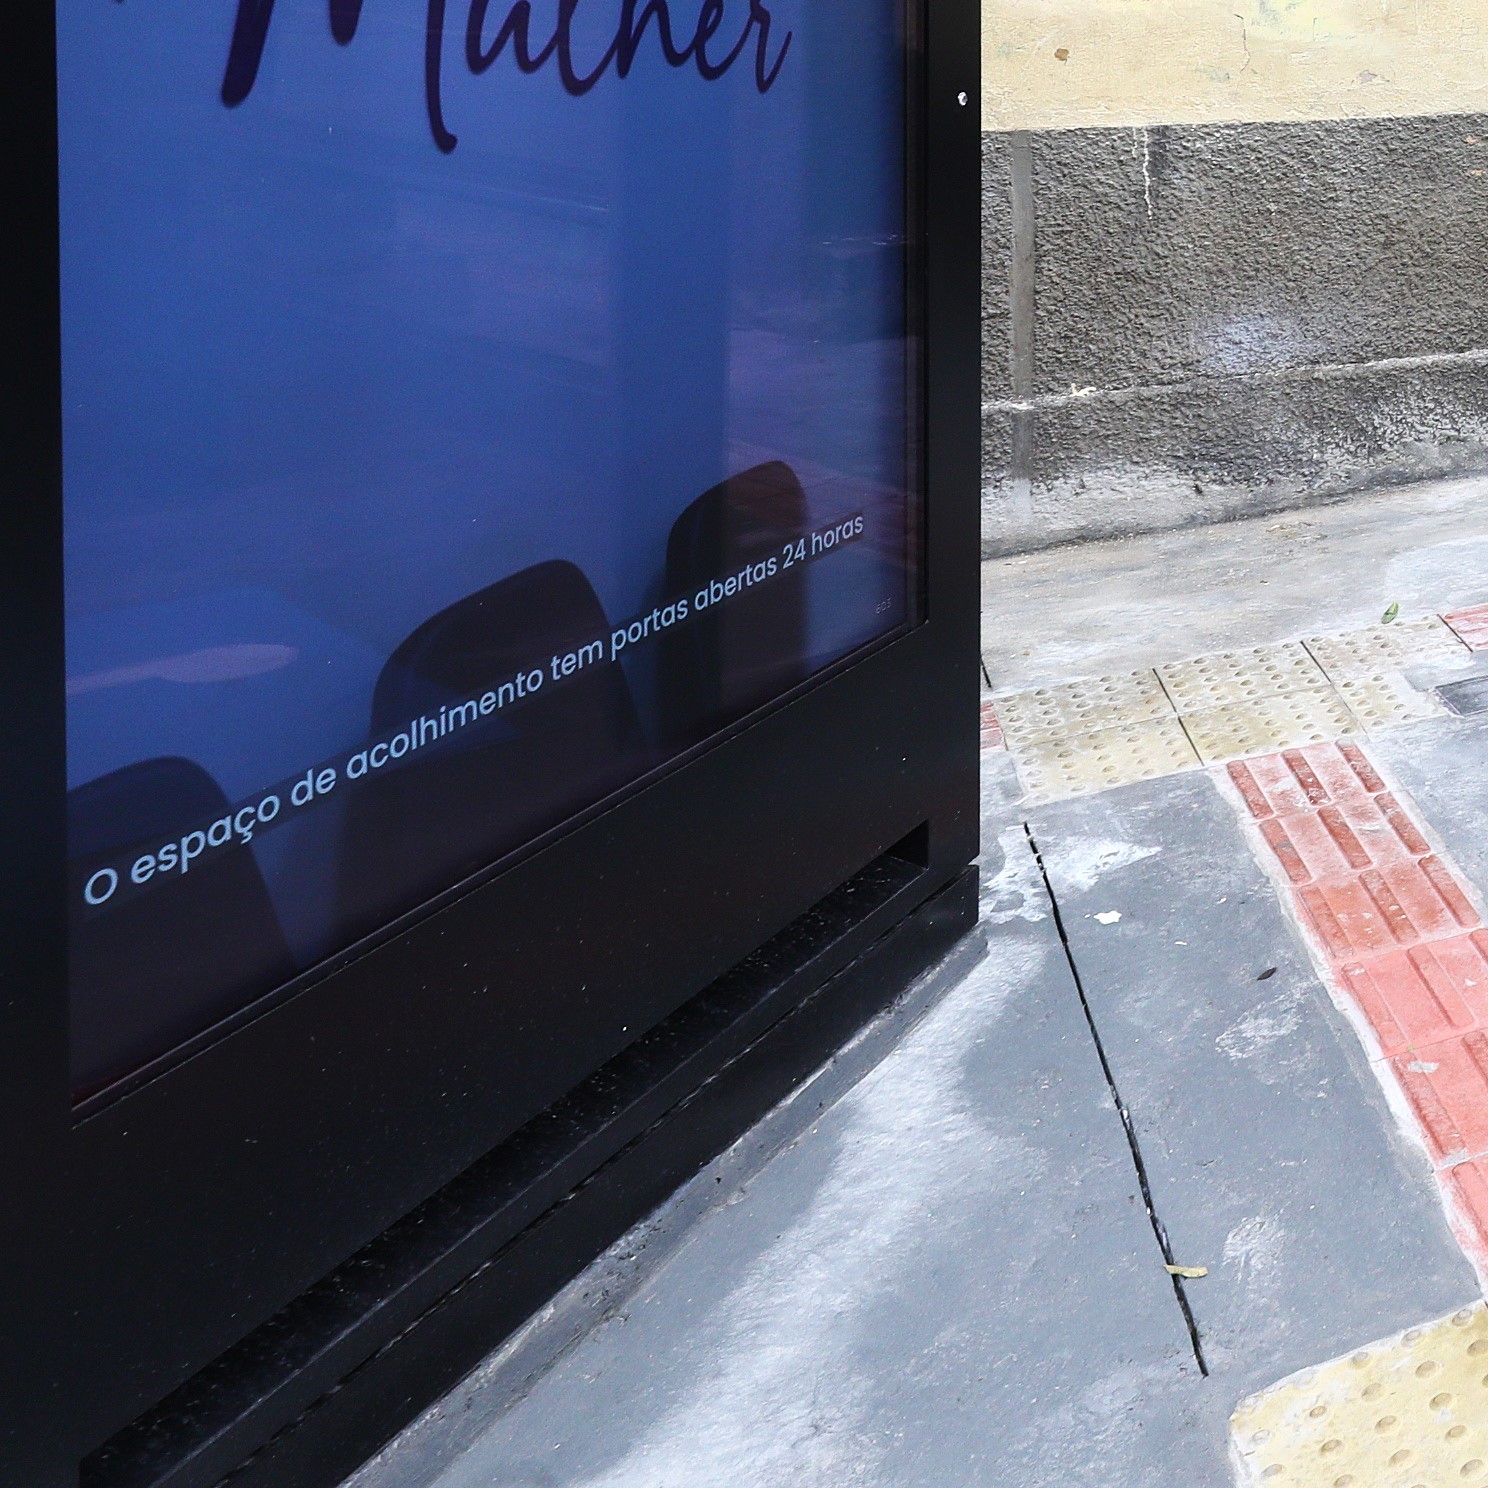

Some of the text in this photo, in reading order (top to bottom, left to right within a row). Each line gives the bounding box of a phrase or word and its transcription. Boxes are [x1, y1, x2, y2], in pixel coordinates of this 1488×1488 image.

[84, 514, 865, 906] O espaço de acolhimento tem portas abertas 24 horas
